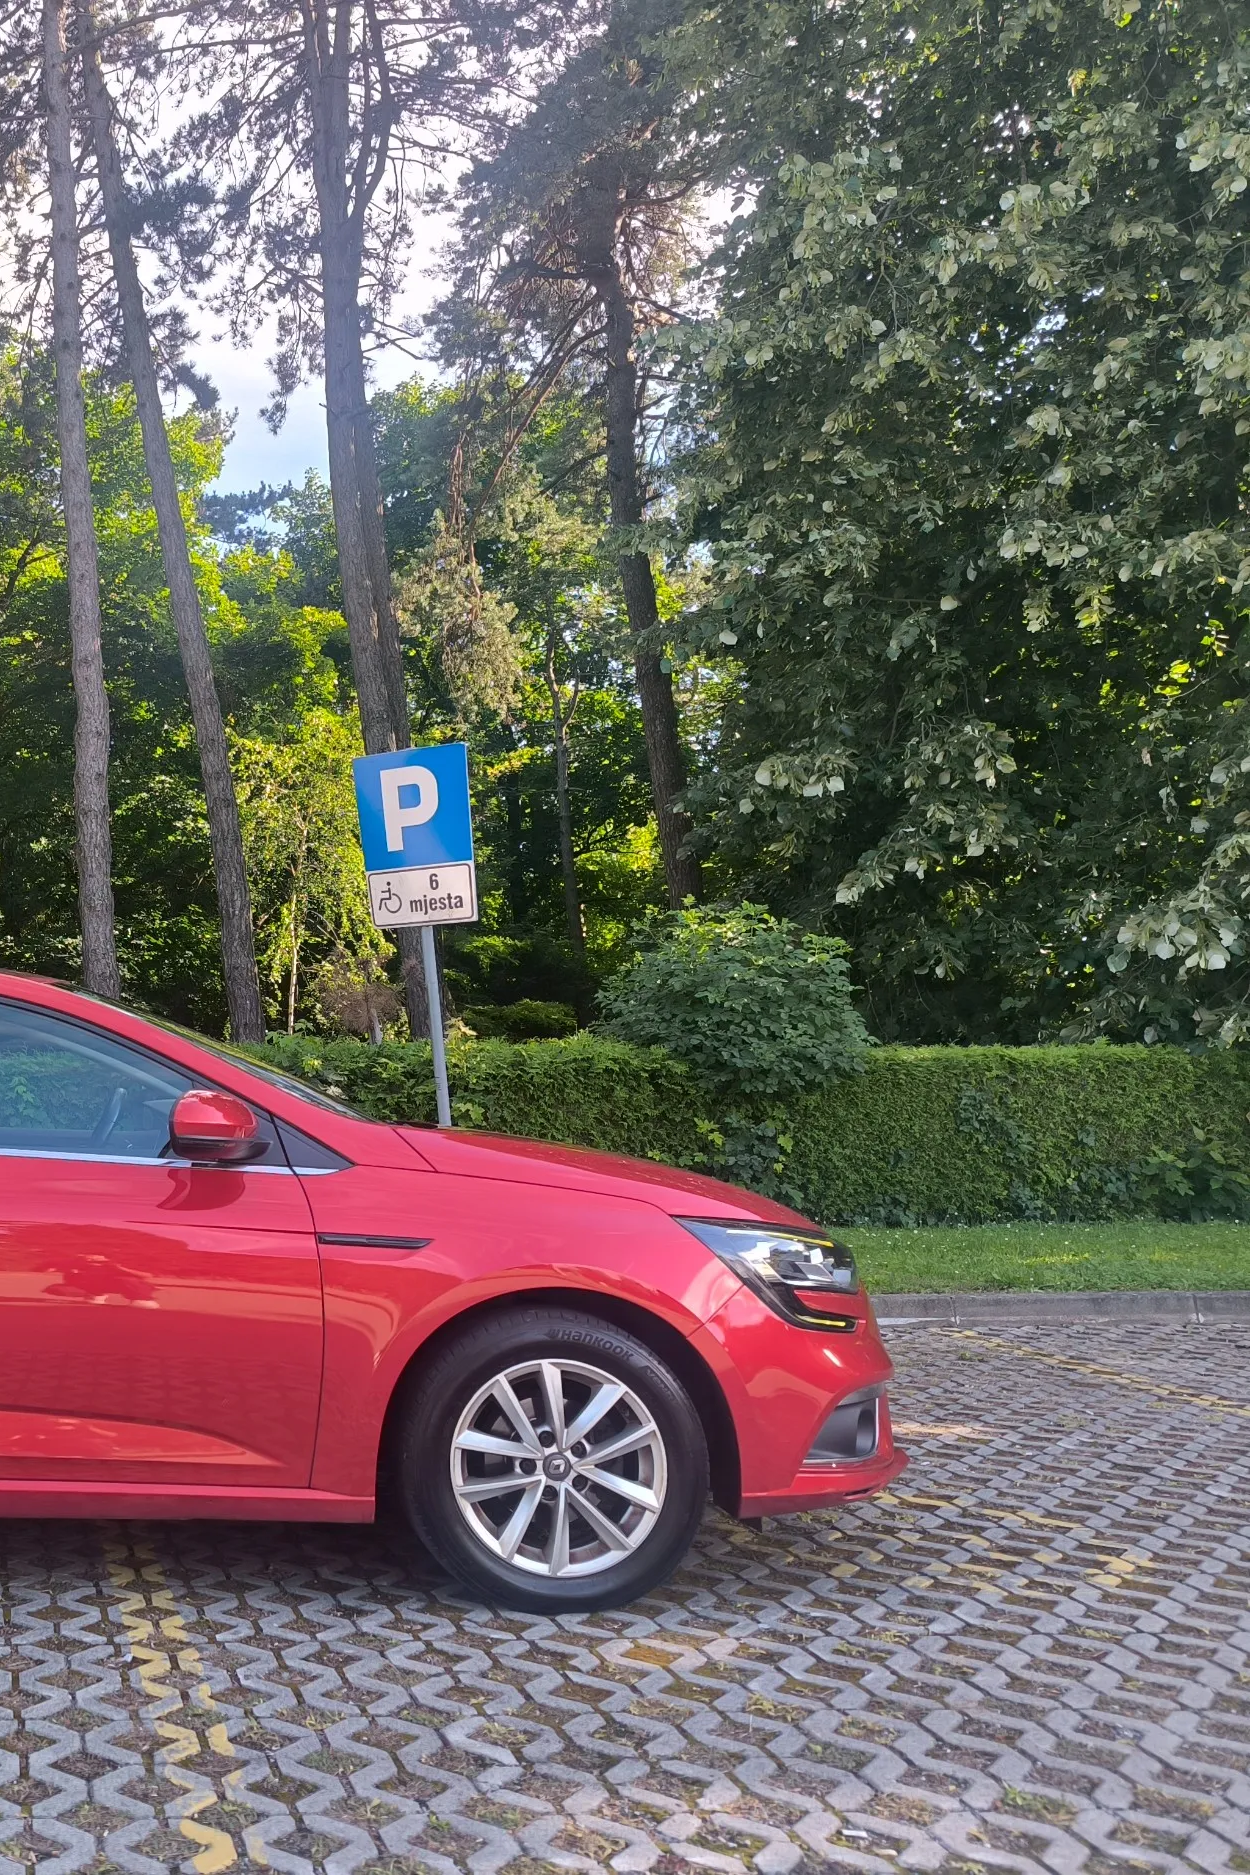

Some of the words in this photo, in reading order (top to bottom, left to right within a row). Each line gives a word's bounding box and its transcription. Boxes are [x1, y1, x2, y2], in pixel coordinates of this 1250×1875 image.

[380, 765, 438, 852] P
[429, 873, 439, 890] 6
[410, 893, 463, 915] mjesta
